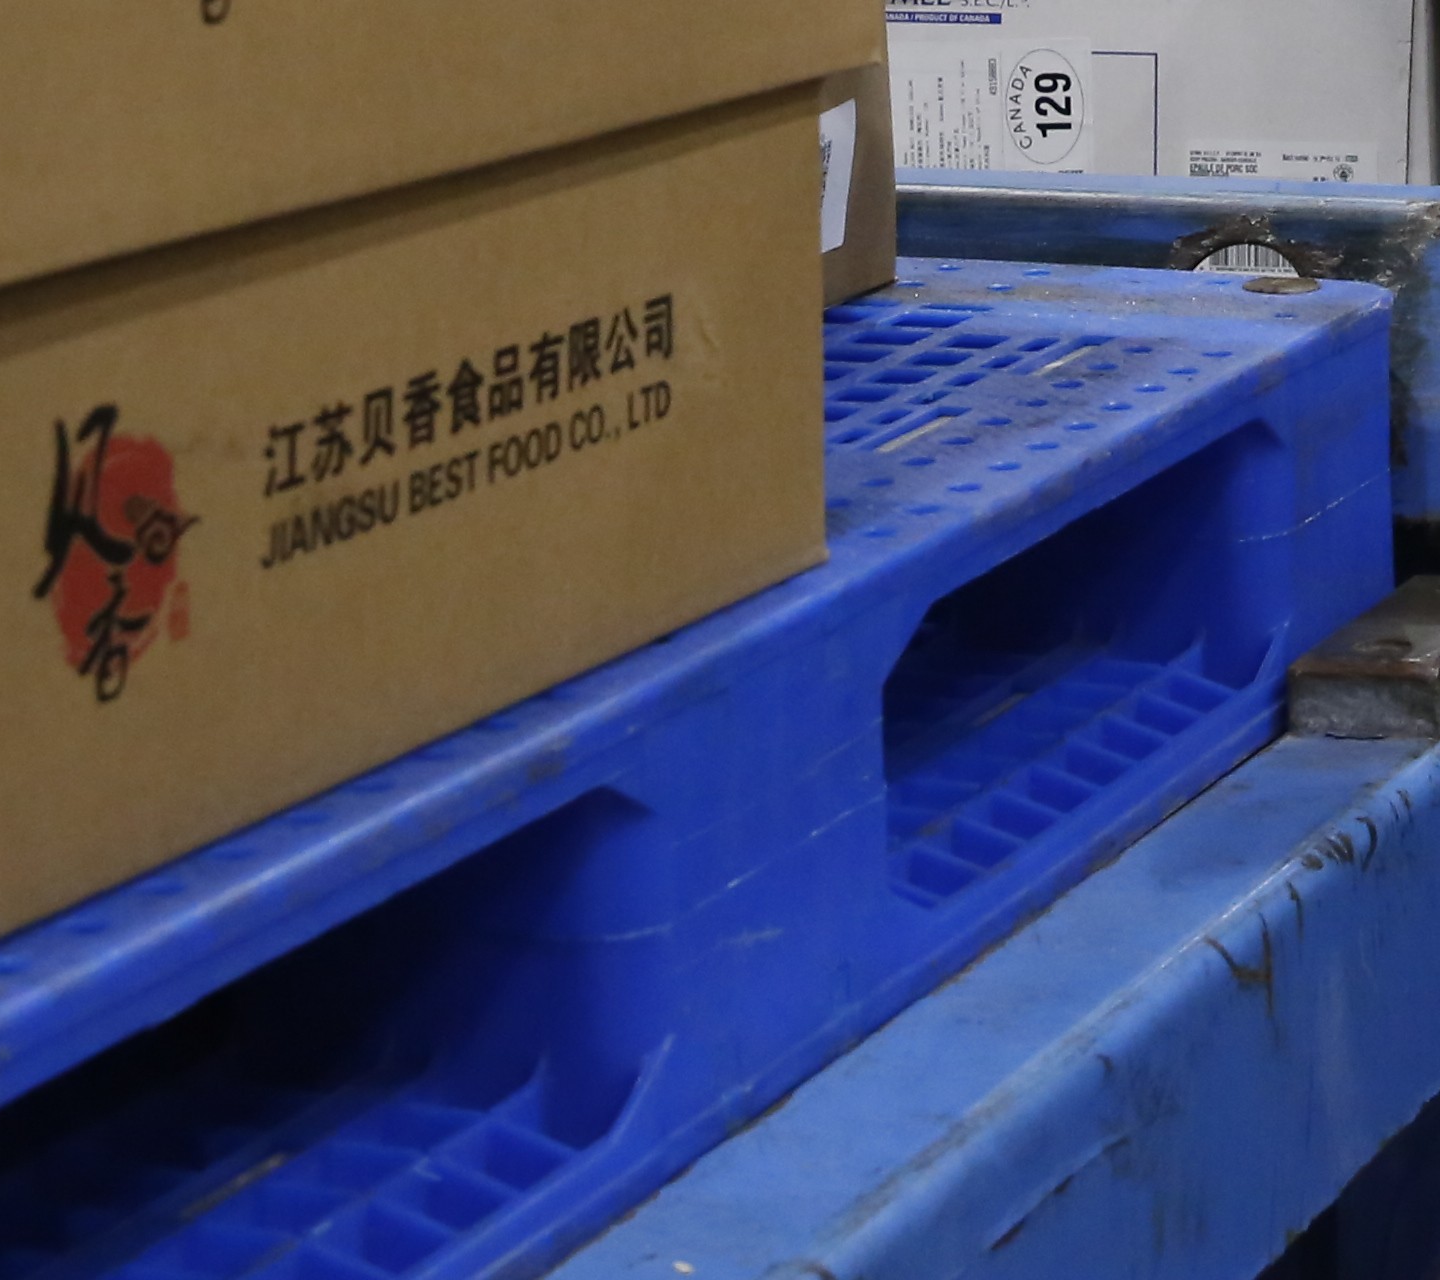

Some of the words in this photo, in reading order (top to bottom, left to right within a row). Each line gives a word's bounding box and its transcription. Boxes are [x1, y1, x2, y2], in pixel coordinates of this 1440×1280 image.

[959, 14, 990, 23] CANADA
[1009, 64, 1033, 150] CANADA
[1033, 72, 1072, 139] 129
[263, 292, 675, 500] 江苏贝香食品有限公司
[261, 482, 399, 570] JIANGSU
[408, 449, 480, 517] BEST
[486, 423, 561, 487] FOOD
[627, 380, 672, 435] LTD
